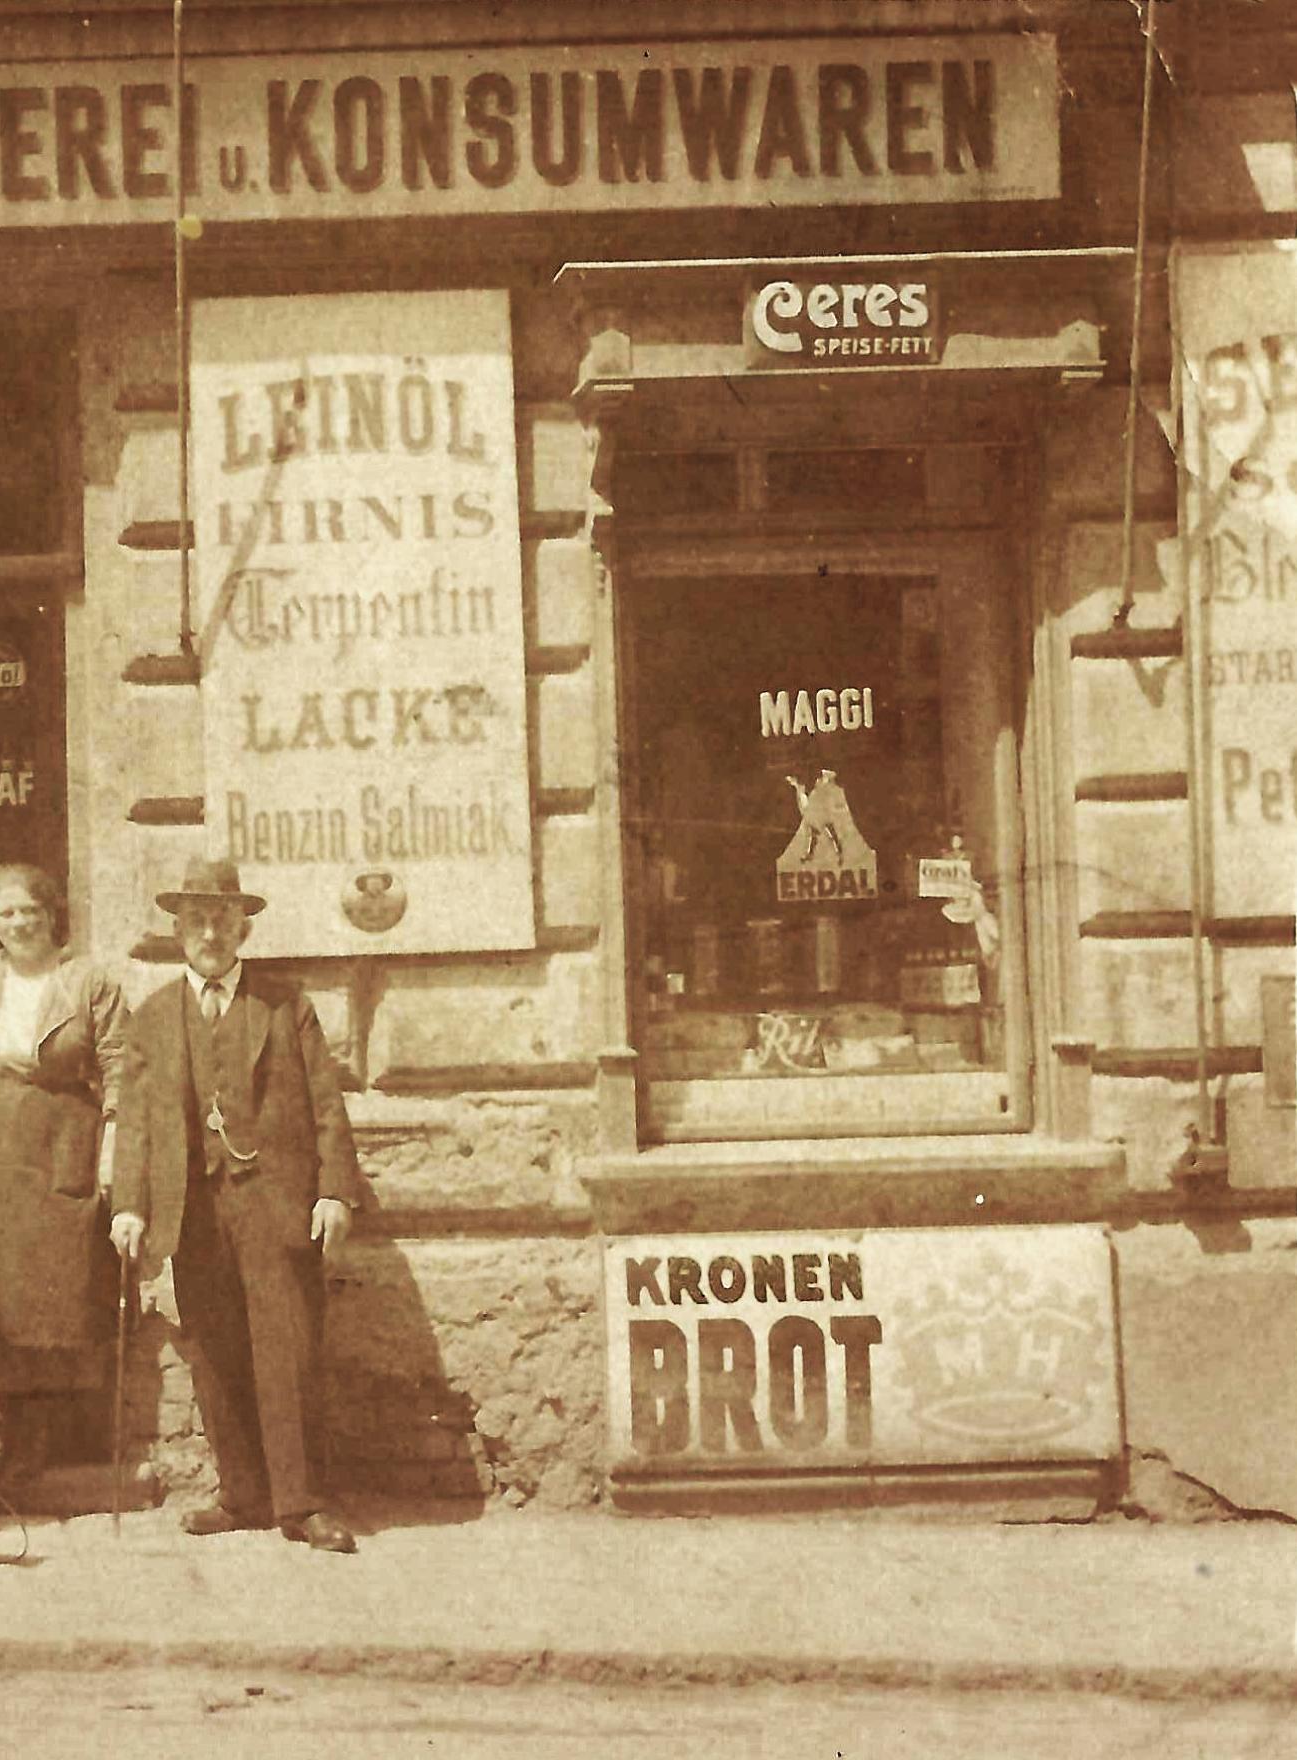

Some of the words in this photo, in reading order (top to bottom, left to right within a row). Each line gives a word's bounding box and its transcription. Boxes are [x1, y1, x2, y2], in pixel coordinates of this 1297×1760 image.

[266, 60, 996, 193] KONSUMWAREN
[753, 281, 929, 352] Ceres
[813, 337, 932, 356] SPEISE-FETT
[217, 355, 499, 474] LEINÖL
[239, 684, 487, 751] LACKE
[759, 688, 873, 738] MAGGI
[779, 870, 874, 900] ERDAL
[625, 1253, 864, 1306] KRONEN
[628, 1314, 883, 1455] BROT
